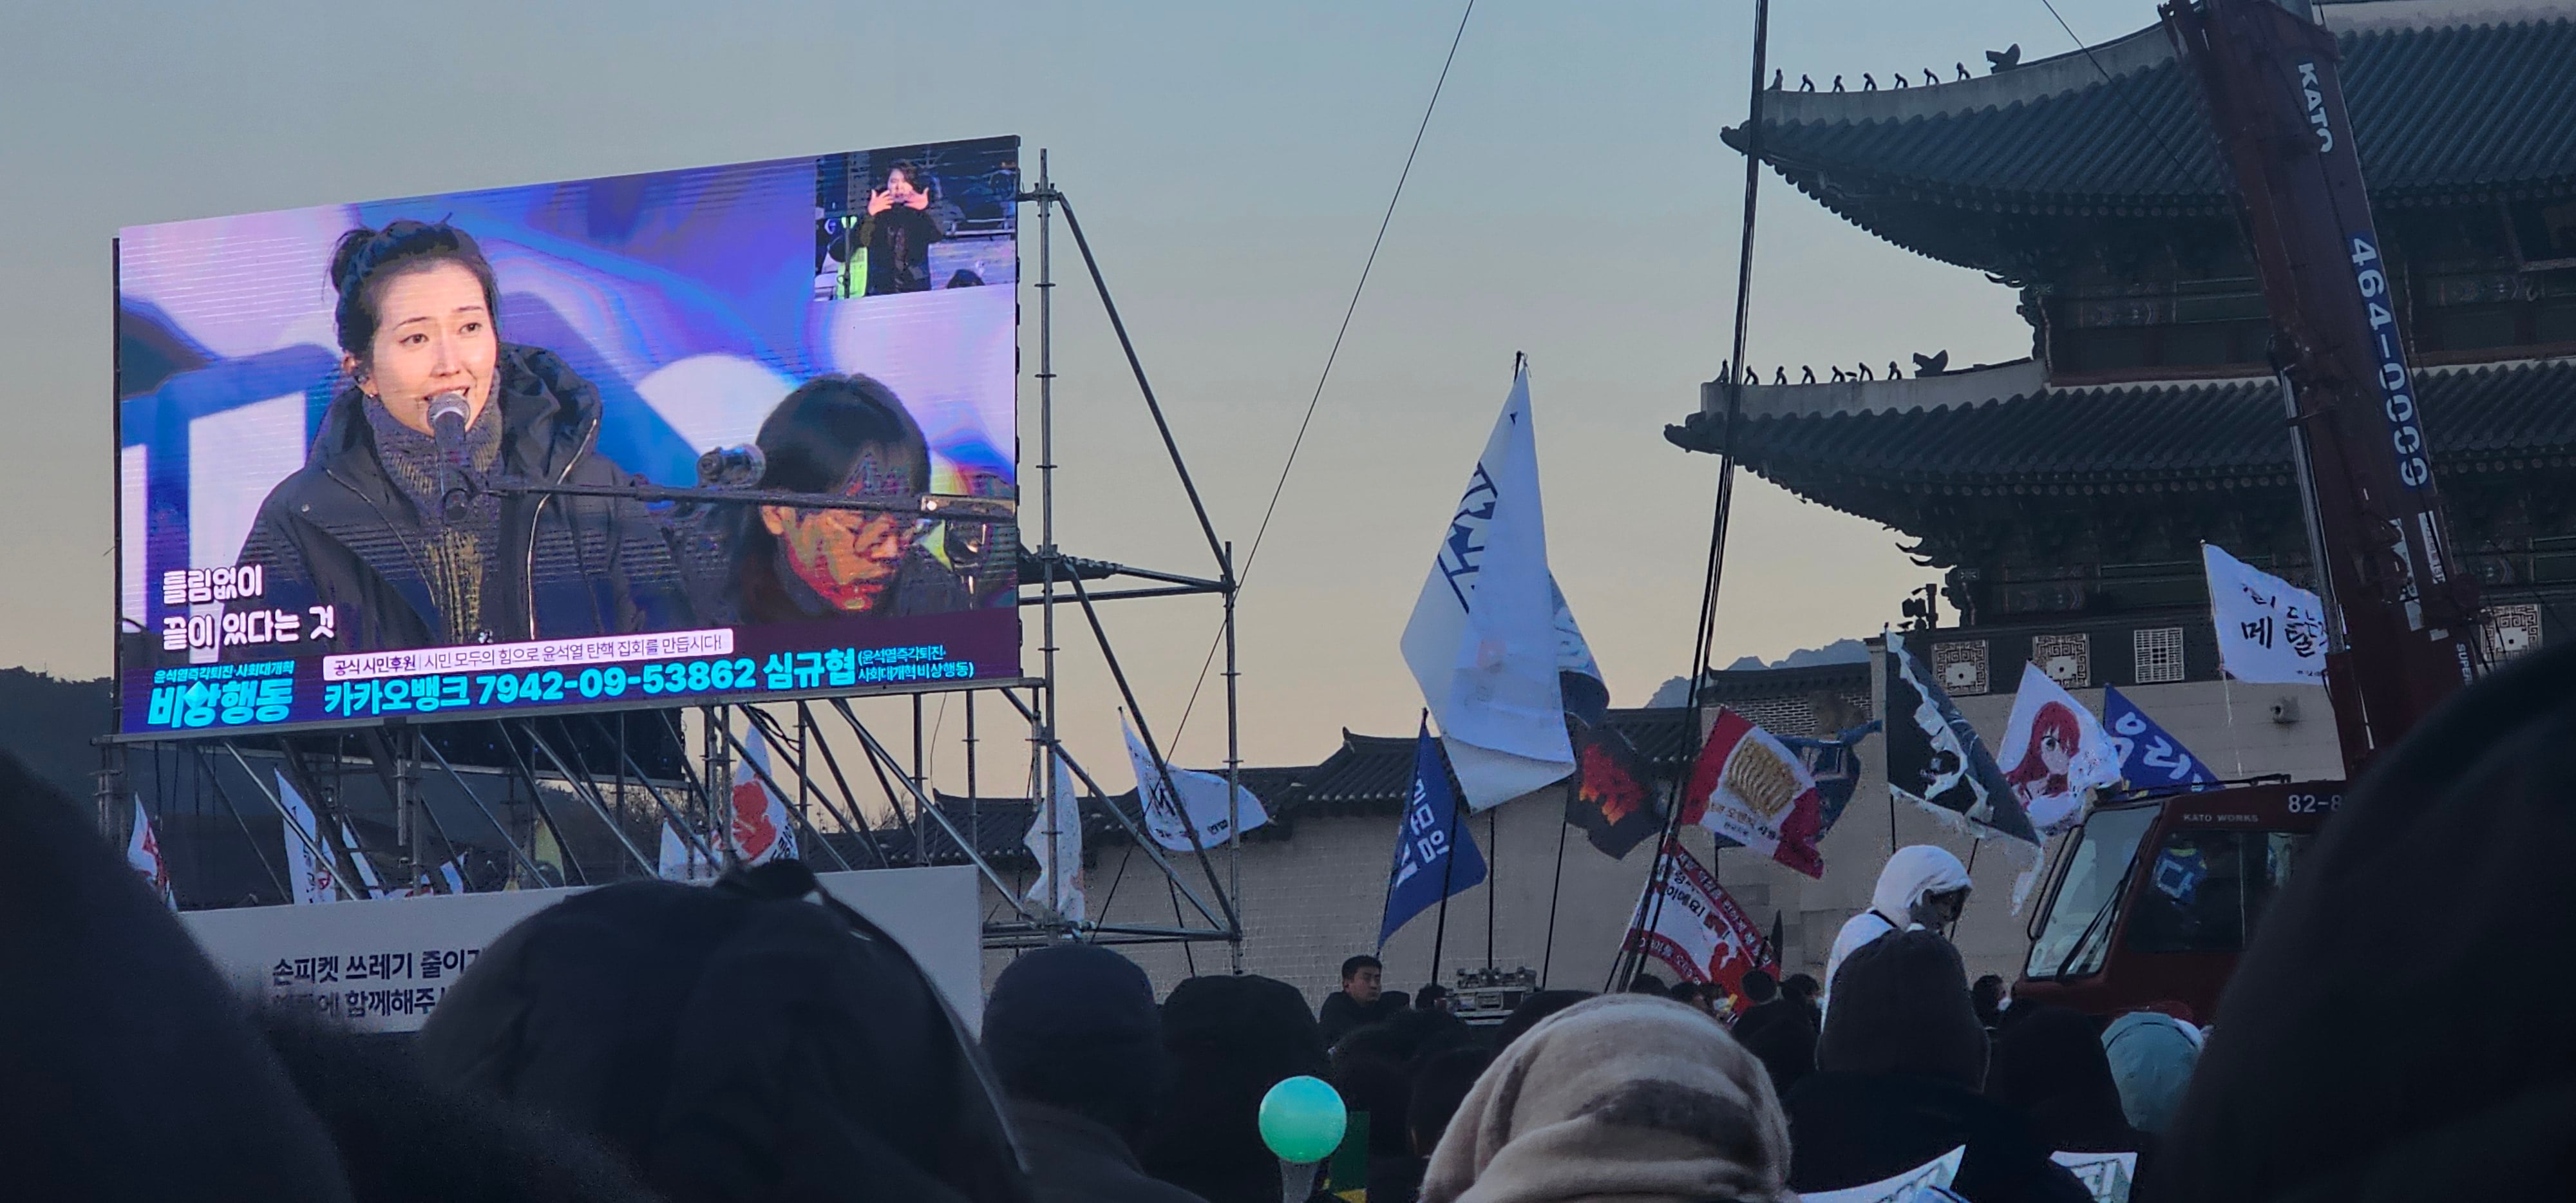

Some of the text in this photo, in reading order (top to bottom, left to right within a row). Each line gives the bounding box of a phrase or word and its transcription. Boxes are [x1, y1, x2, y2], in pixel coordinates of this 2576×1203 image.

[2297, 61, 2333, 154] KATO
[162, 565, 263, 605] 틀림없이
[162, 605, 336, 651] 끝이 있다는 것
[333, 659, 361, 676] 공식
[424, 652, 451, 669] 시민
[455, 649, 495, 667] 모두의
[498, 647, 540, 665] 힘으로
[543, 643, 583, 662] 윤석열
[587, 641, 613, 659] 탄핵
[617, 638, 659, 657] 집회를
[662, 634, 722, 654] 만듭시다!
[324, 647, 856, 717] 카카오뱅크 7942-09-53862 심규협
[2183, 813, 2259, 823] KATO WORKS
[272, 956, 339, 986] 손피켓
[345, 952, 413, 980] 쓰레기
[345, 987, 446, 1018] 함께해주
